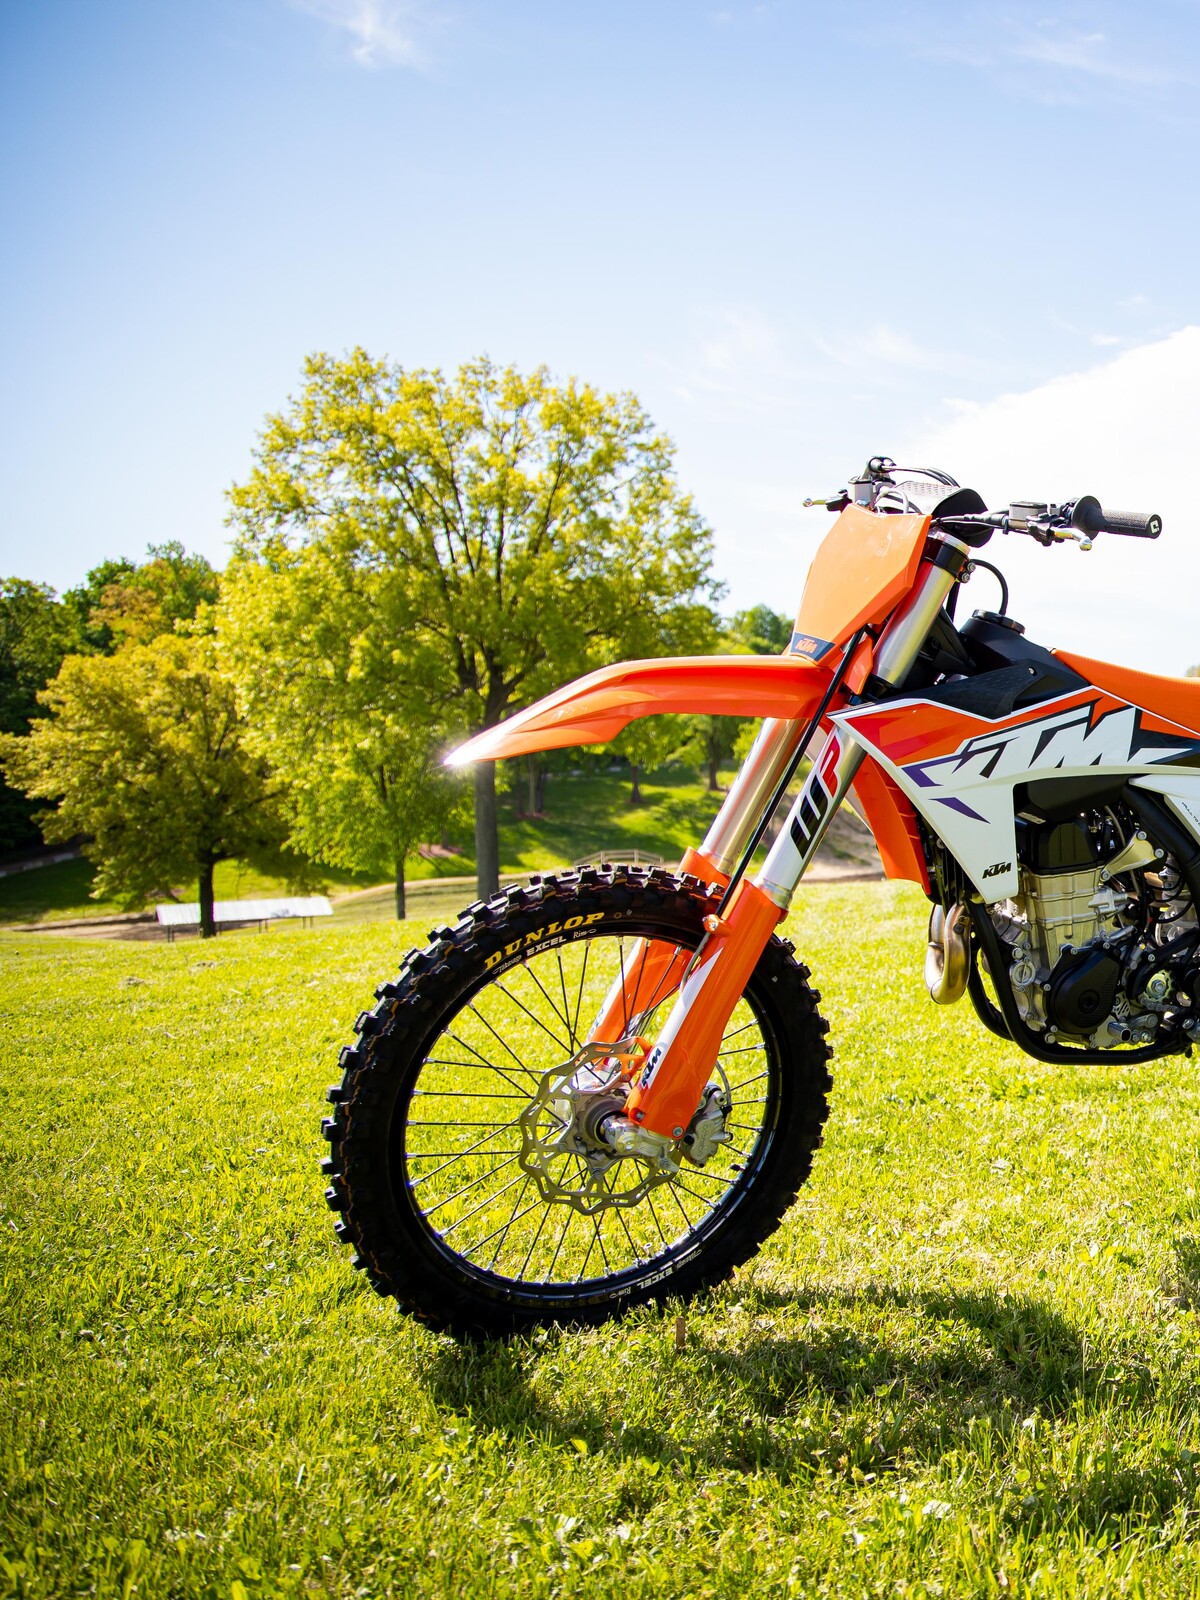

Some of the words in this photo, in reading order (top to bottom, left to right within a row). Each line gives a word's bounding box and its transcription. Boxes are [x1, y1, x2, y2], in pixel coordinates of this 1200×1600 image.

[794, 638, 818, 654] KTM
[904, 704, 1193, 800] KTM
[981, 861, 1012, 879] KTM
[484, 912, 605, 971] DUNLOP
[526, 935, 567, 957] EXCEL
[641, 1047, 662, 1087] KTM
[636, 1266, 673, 1289] EXCEL
